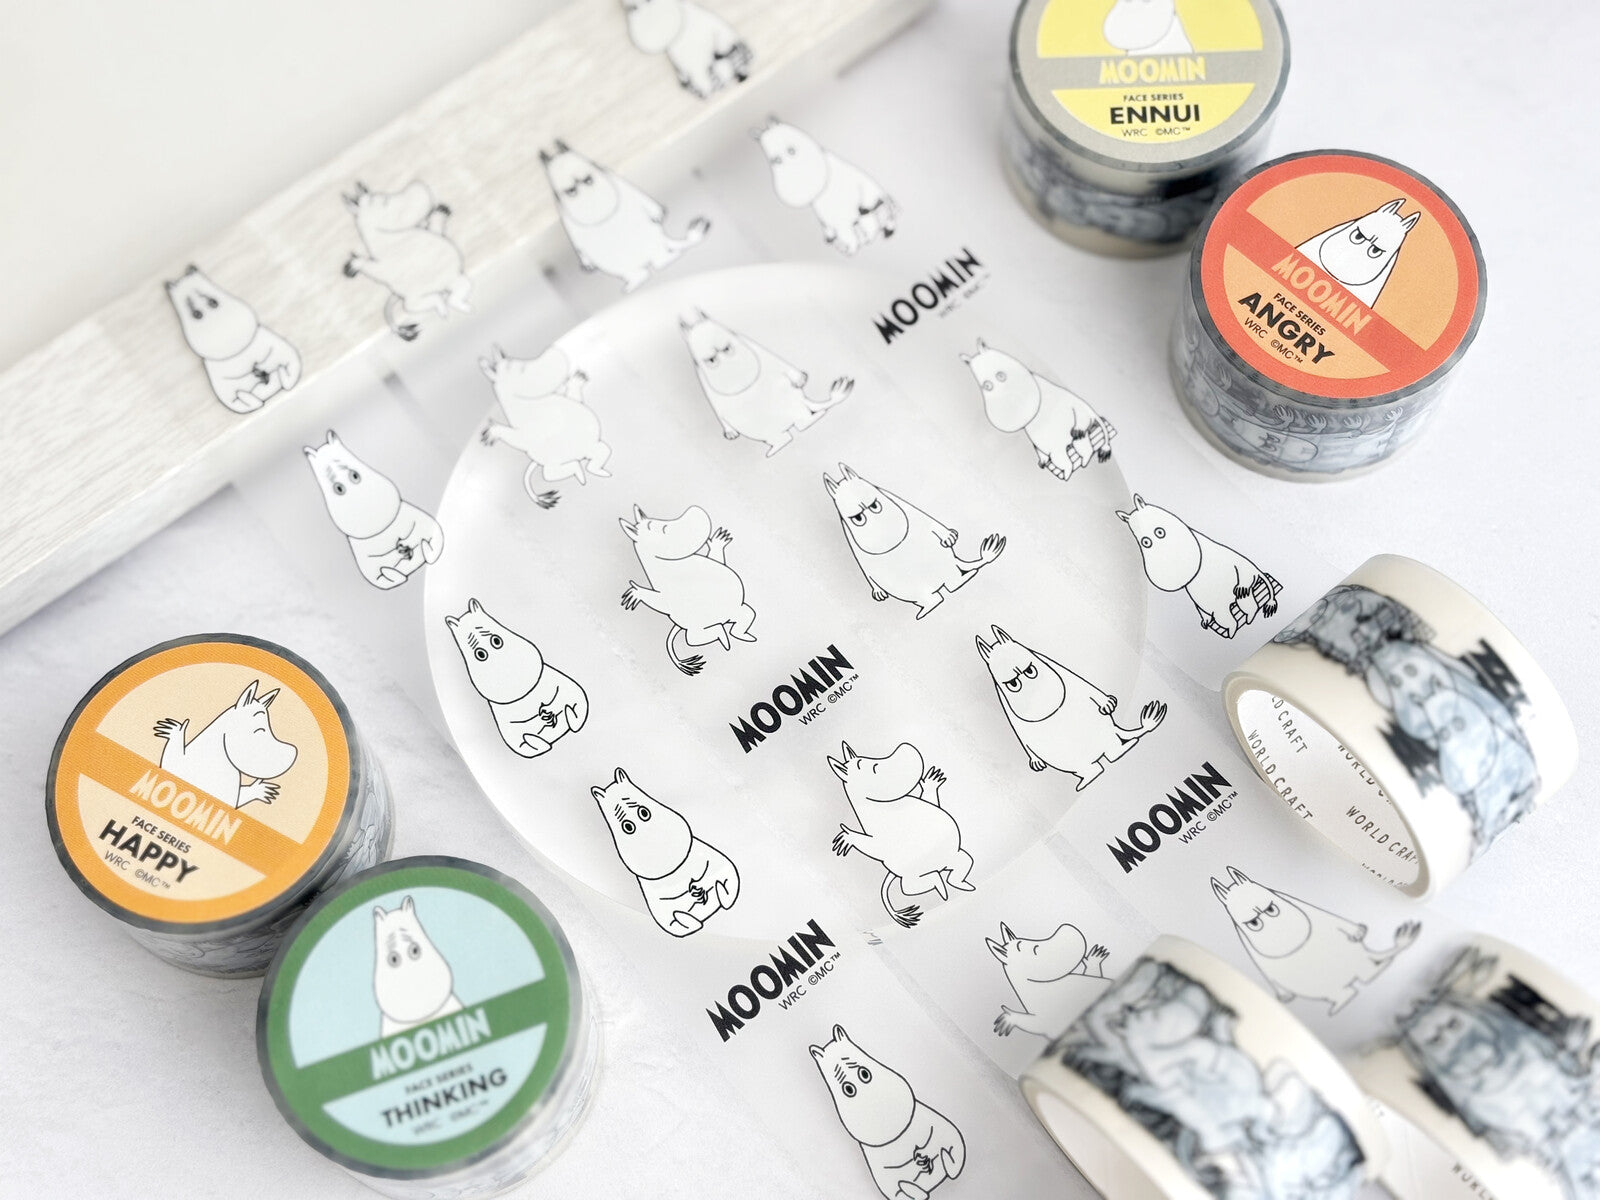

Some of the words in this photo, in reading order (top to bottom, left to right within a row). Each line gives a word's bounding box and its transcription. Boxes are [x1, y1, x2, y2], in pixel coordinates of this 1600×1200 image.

[1099, 56, 1206, 85] MOOMIN
[1110, 104, 1200, 124] ENNUI
[1123, 94, 1147, 102] FACE
[1150, 93, 1184, 101] SERIES
[1122, 128, 1148, 137] WRC
[872, 248, 983, 345] MOOMIN
[1271, 252, 1373, 336] MOOMIN
[1273, 293, 1297, 313] FACE
[1295, 310, 1326, 336] SERIES
[1237, 292, 1335, 364] ANGRY
[1244, 317, 1268, 338] WRC
[728, 644, 854, 754] MOOMIN
[799, 703, 826, 725] WRC
[1277, 710, 1308, 753] CRAFT
[1247, 729, 1276, 774] WORLD
[1274, 777, 1313, 819] CRAFT
[129, 769, 243, 845] MOOMIN
[1106, 761, 1232, 874] MOOMIN
[1345, 805, 1389, 843] WORLD
[98, 819, 200, 883] HAPPY
[131, 816, 157, 836] FACE
[156, 830, 191, 853] SERIES
[1178, 821, 1206, 844] WRC
[104, 850, 131, 871] WRC
[706, 918, 836, 1042] MOOMIN
[778, 985, 807, 1010] WRC
[369, 1007, 492, 1081] MOOMIN
[381, 1067, 508, 1127] THINKING
